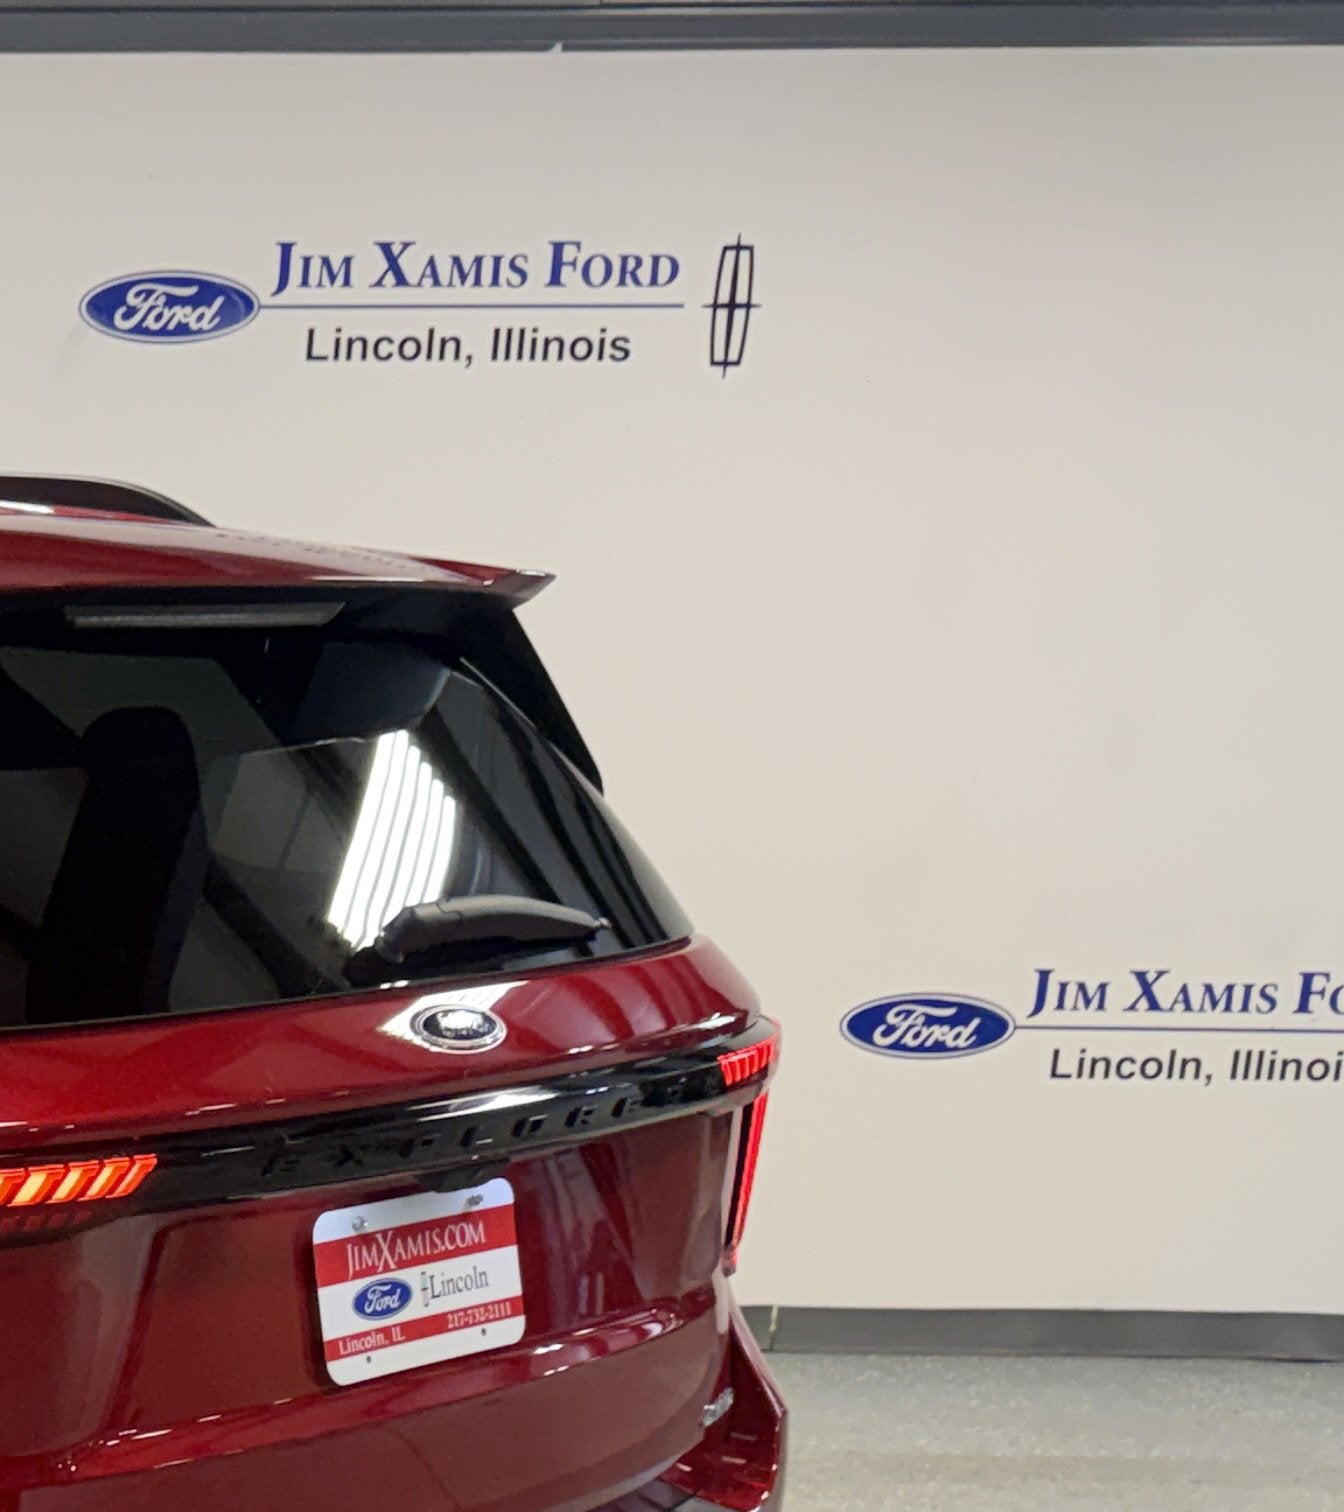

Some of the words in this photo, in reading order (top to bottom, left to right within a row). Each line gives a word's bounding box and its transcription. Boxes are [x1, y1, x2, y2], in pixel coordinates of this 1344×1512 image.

[270, 242, 354, 297] JIM
[369, 241, 528, 288] XAMIS
[545, 241, 679, 288] FORD
[113, 281, 226, 331] Ford
[306, 327, 472, 368] Lincoln,
[491, 327, 630, 362] Illinois
[1026, 968, 1110, 1019] JIM
[1123, 969, 1278, 1015] XAMIS
[873, 1003, 982, 1049] Ford
[1050, 1048, 1212, 1086] Lincoln,
[364, 1284, 401, 1314] Ford
[428, 1265, 489, 1299] Lincoln
[392, 1326, 406, 1342] IL
